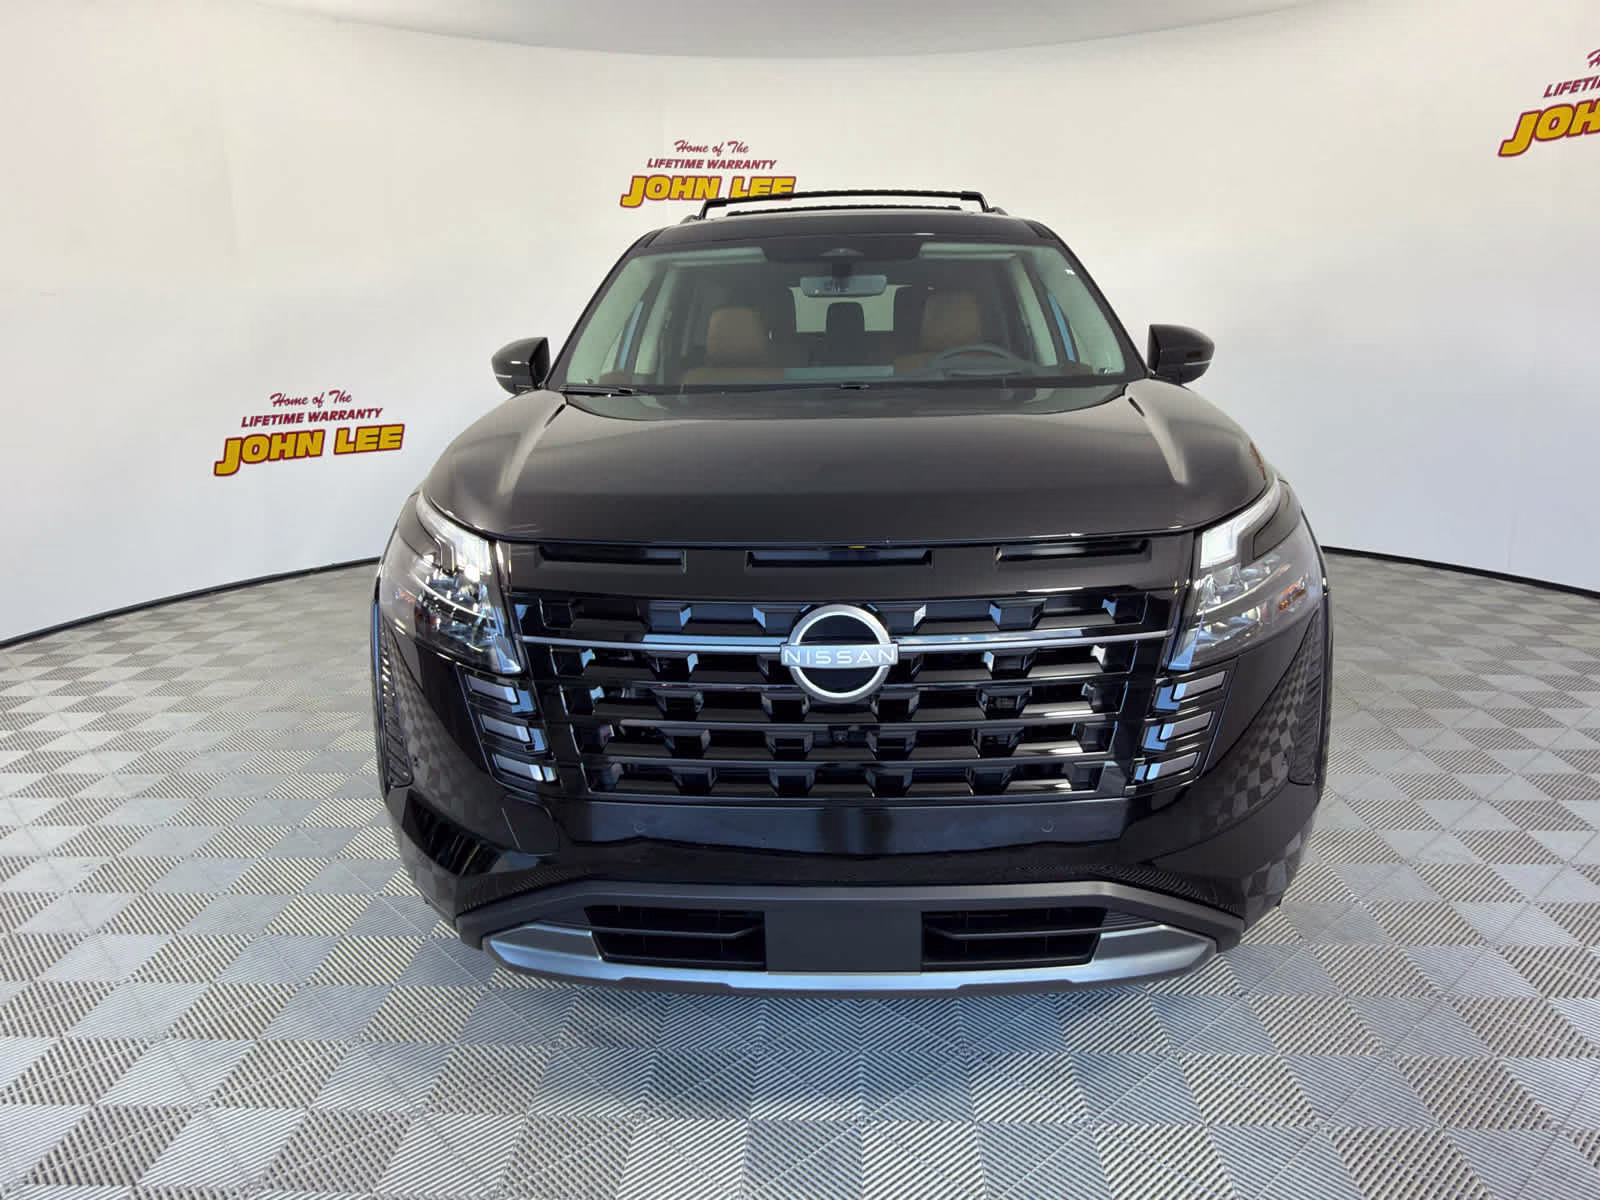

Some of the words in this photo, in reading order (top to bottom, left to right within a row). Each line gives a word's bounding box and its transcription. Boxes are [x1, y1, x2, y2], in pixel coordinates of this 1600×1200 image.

[1543, 75, 1600, 98] LIFETI
[674, 140, 708, 153] Home
[712, 142, 724, 156] of
[727, 141, 749, 153] The
[647, 158, 704, 169] LIFETIME
[707, 160, 777, 170] WARRANTY
[620, 174, 722, 208] JOHN
[729, 176, 796, 200] LEE
[270, 393, 308, 407] Home
[312, 392, 324, 408] of
[329, 390, 352, 404] The
[241, 412, 304, 427] LIFETIME
[308, 408, 383, 422] WARRANTY
[214, 429, 325, 476] JOHN
[334, 424, 405, 455] LEE
[784, 648, 895, 665] NISSAN
